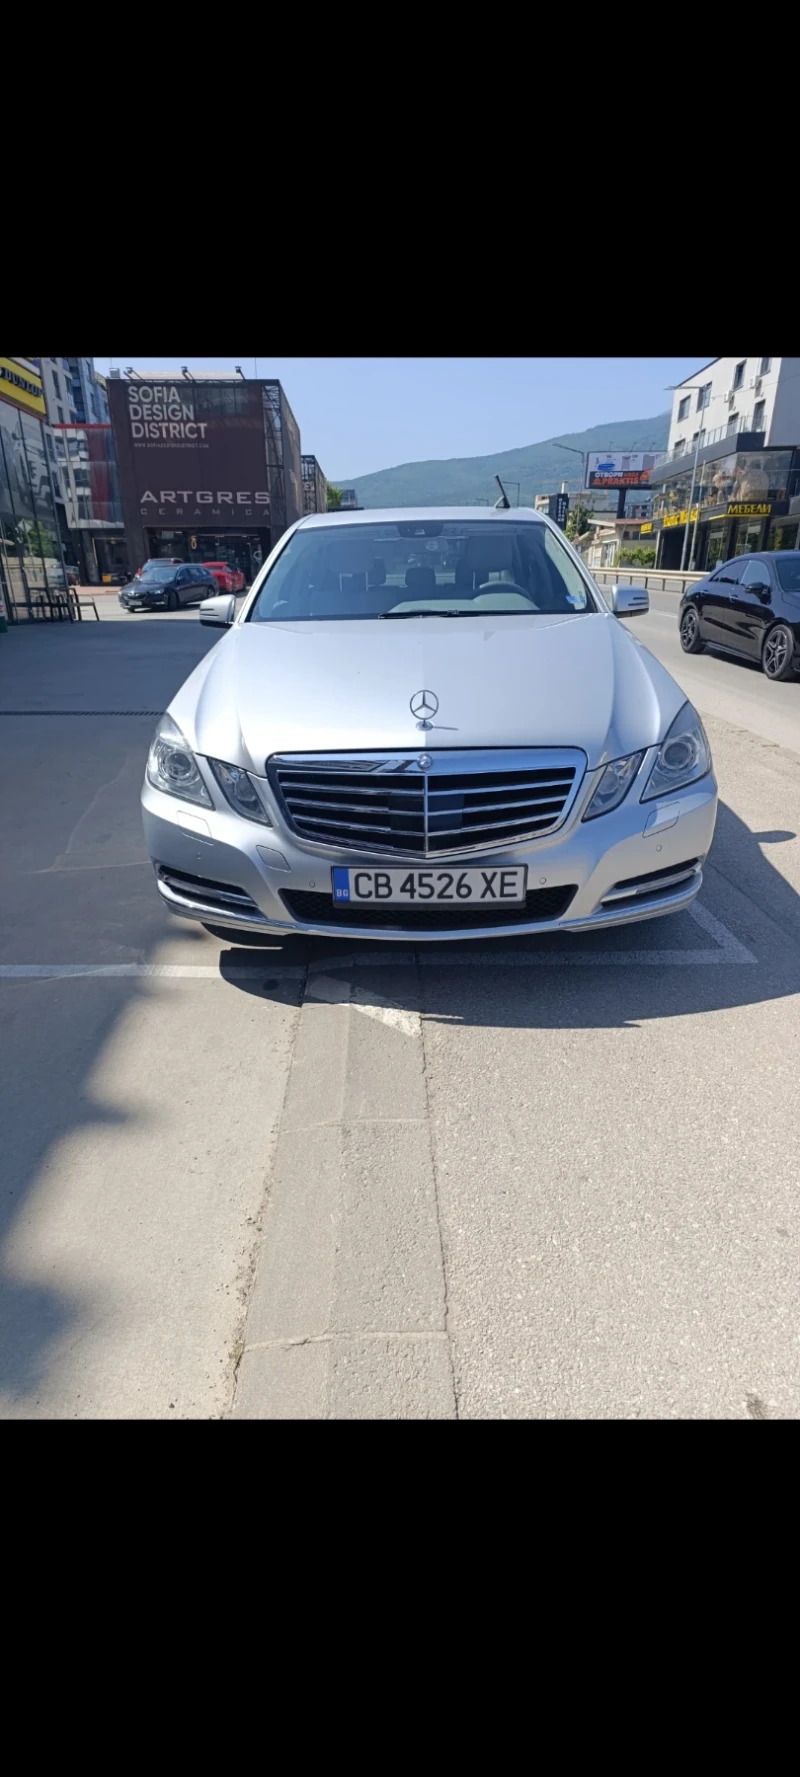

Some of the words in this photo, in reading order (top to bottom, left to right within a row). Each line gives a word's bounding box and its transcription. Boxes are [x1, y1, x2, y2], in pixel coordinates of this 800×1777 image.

[128, 385, 181, 403] SOFIA
[129, 404, 195, 421] DESIGN
[131, 422, 208, 439] DISTRICT
[140, 490, 271, 505] ARTGRES
[140, 507, 271, 516] CERAMICA
[727, 503, 772, 515] МЕБЕЛИ
[336, 888, 349, 897] BG
[399, 872, 473, 899] 4526
